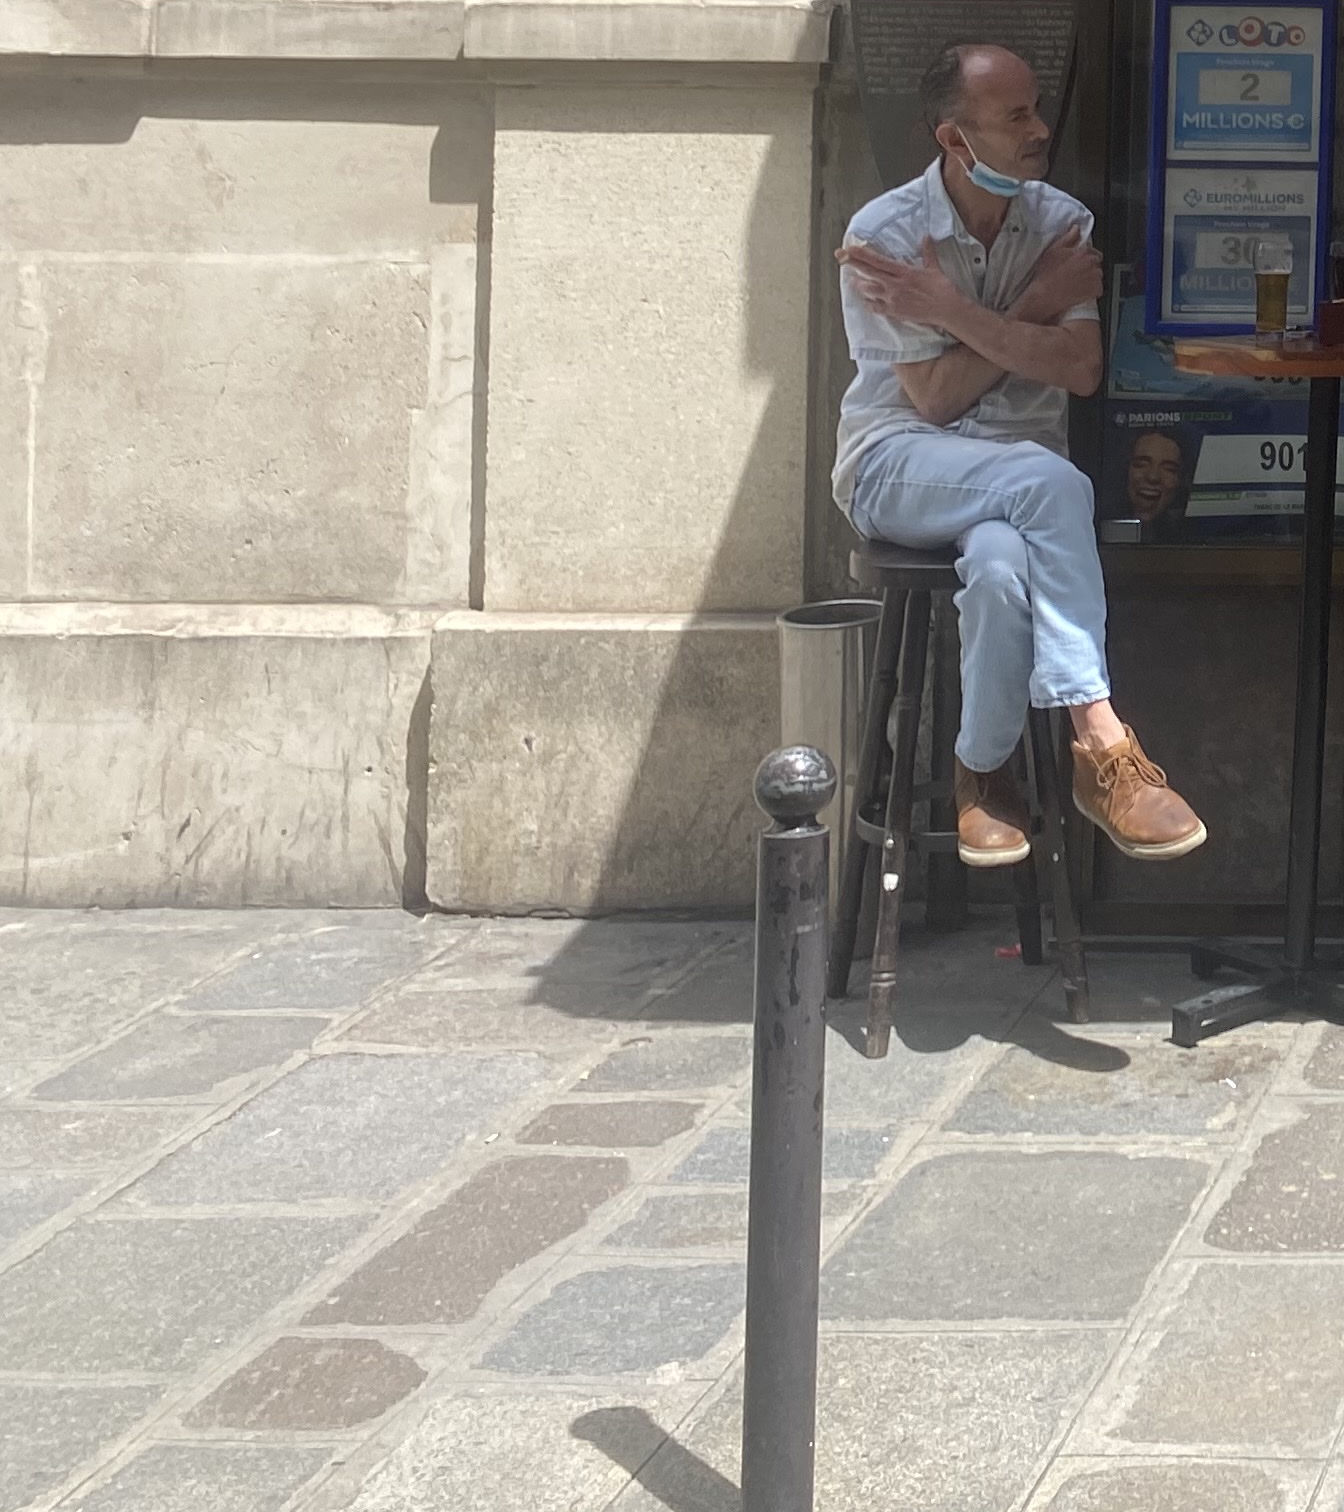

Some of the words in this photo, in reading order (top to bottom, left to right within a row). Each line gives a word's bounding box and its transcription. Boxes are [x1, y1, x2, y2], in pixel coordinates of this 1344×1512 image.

[1219, 16, 1305, 47] LOTO
[1240, 72, 1260, 101] 2
[1182, 111, 1284, 129] MILLIONS
[1206, 192, 1304, 205] EUROMILLIONS
[1128, 412, 1181, 423] PARIONS
